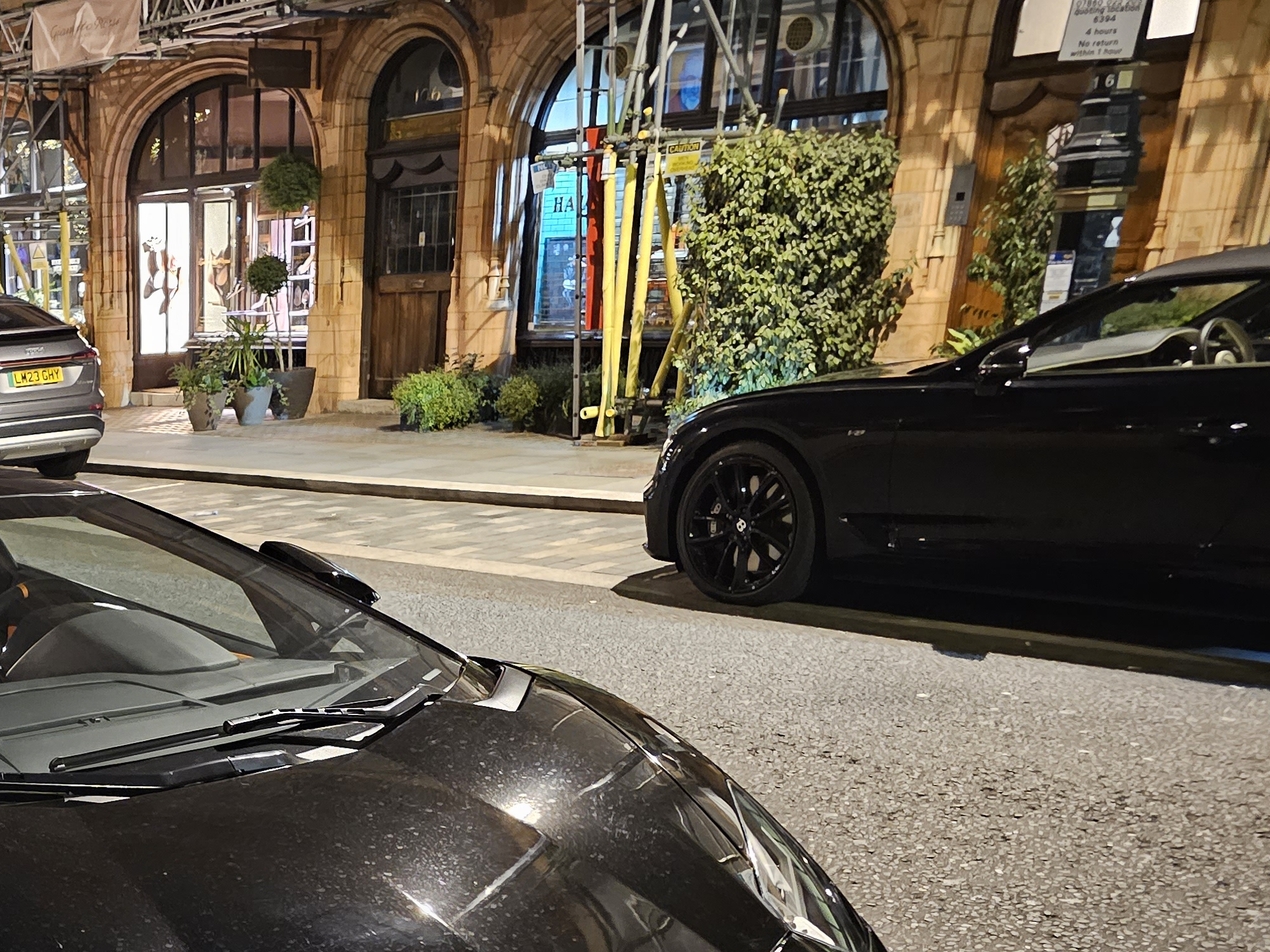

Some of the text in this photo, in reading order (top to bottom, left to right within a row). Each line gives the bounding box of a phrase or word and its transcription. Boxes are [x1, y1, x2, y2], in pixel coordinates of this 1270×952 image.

[1074, 4, 1140, 16] quoting location
[1093, 15, 1116, 23] 6394
[1094, 27, 1117, 35] hours
[1078, 39, 1119, 48] No return
[1070, 49, 1095, 57] within
[669, 143, 699, 154] CAUTION
[13, 368, 60, 384] LM23 GHY
